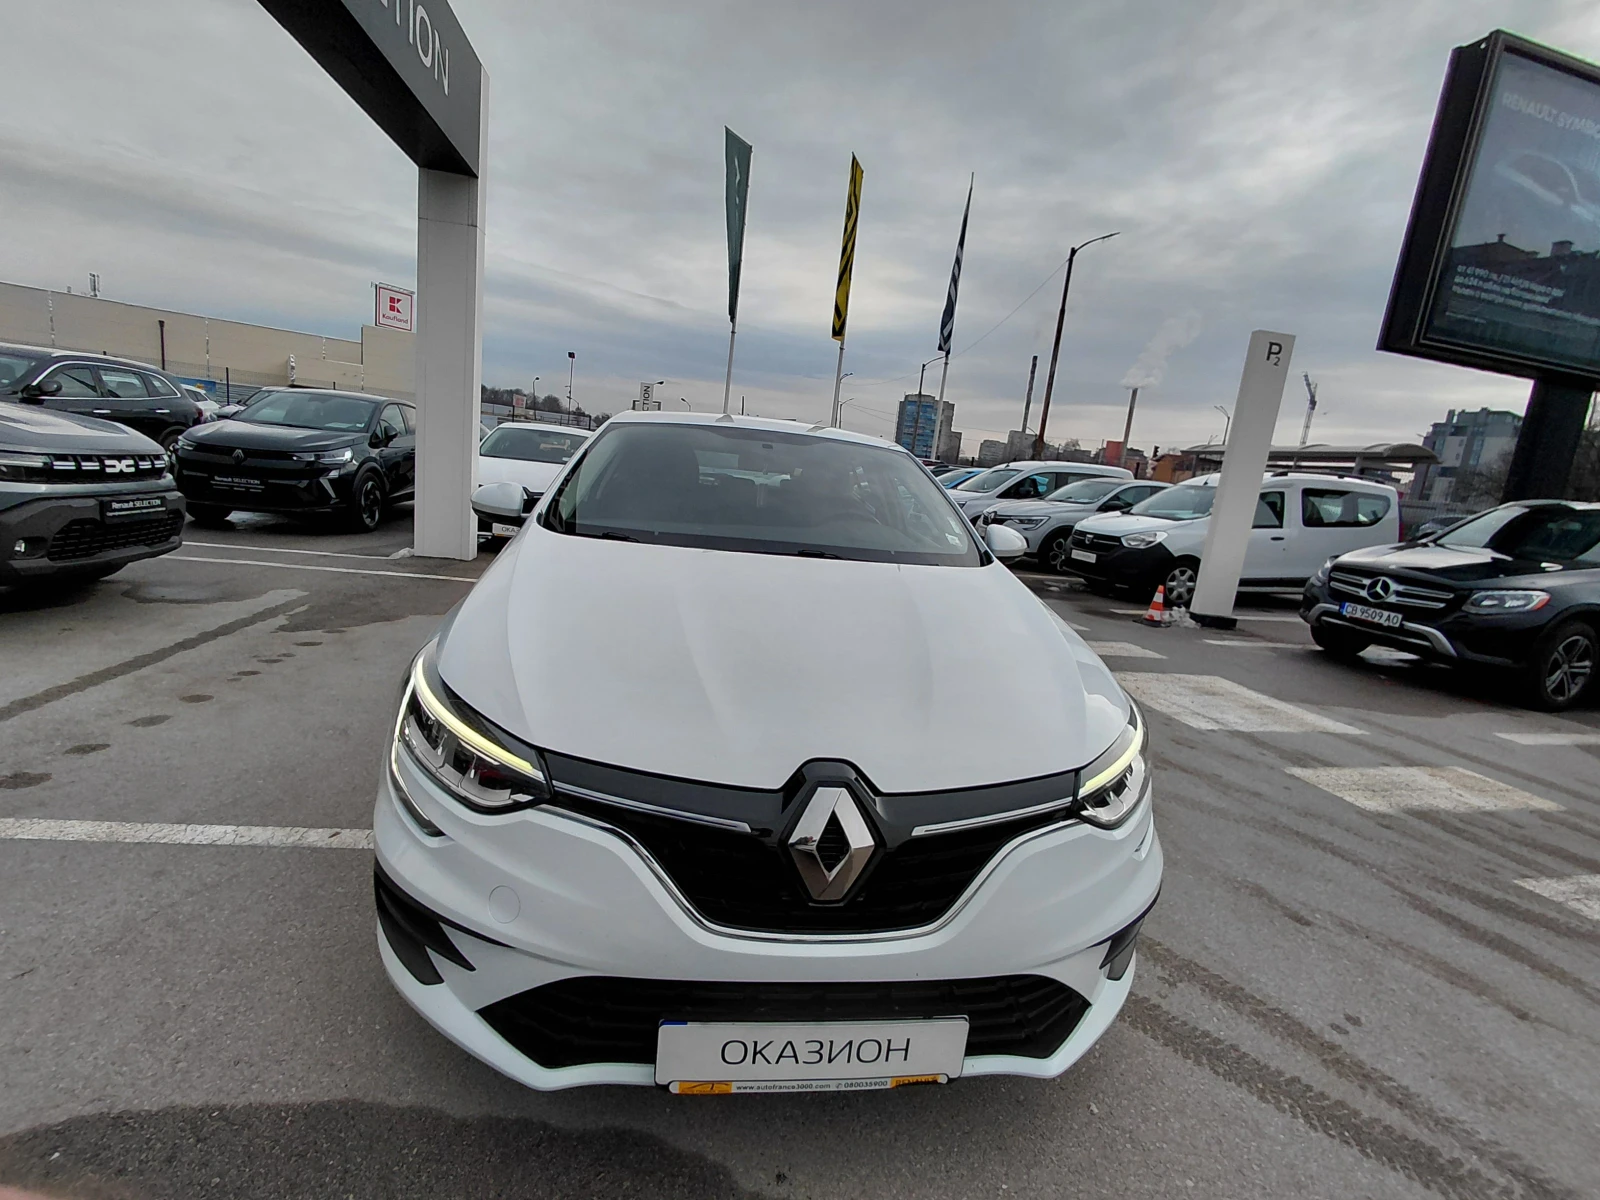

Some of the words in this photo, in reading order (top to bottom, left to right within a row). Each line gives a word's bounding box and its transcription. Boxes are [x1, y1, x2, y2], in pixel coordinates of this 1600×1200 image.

[382, 313, 409, 325] Kaufland
[112, 501, 134, 509] Renault
[134, 499, 161, 507] SELECTION
[1359, 607, 1384, 620] 9509
[720, 1037, 911, 1066] ОКАЗИОН
